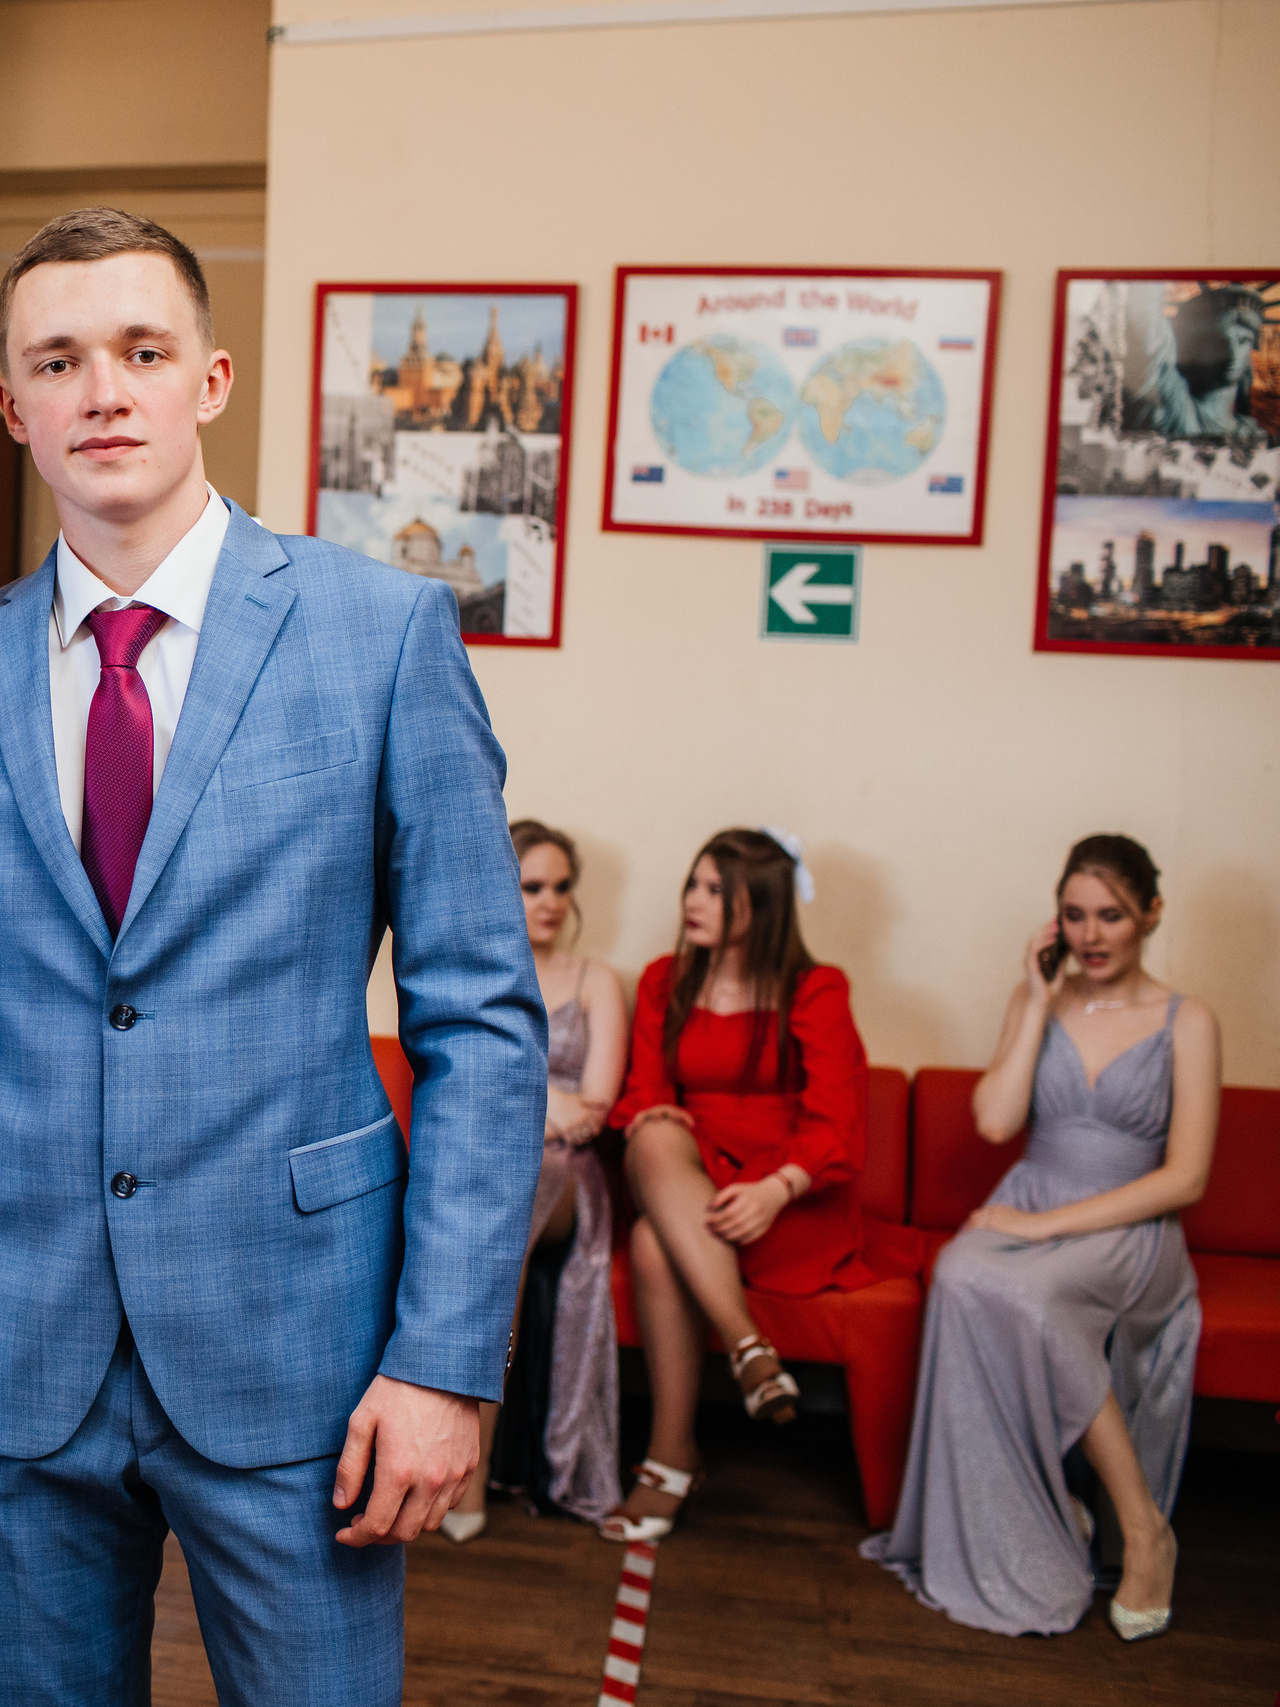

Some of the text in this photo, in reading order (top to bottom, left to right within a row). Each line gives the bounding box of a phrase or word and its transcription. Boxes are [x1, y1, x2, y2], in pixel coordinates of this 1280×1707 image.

[696, 286, 917, 321] Around the World
[804, 498, 853, 522] Days
